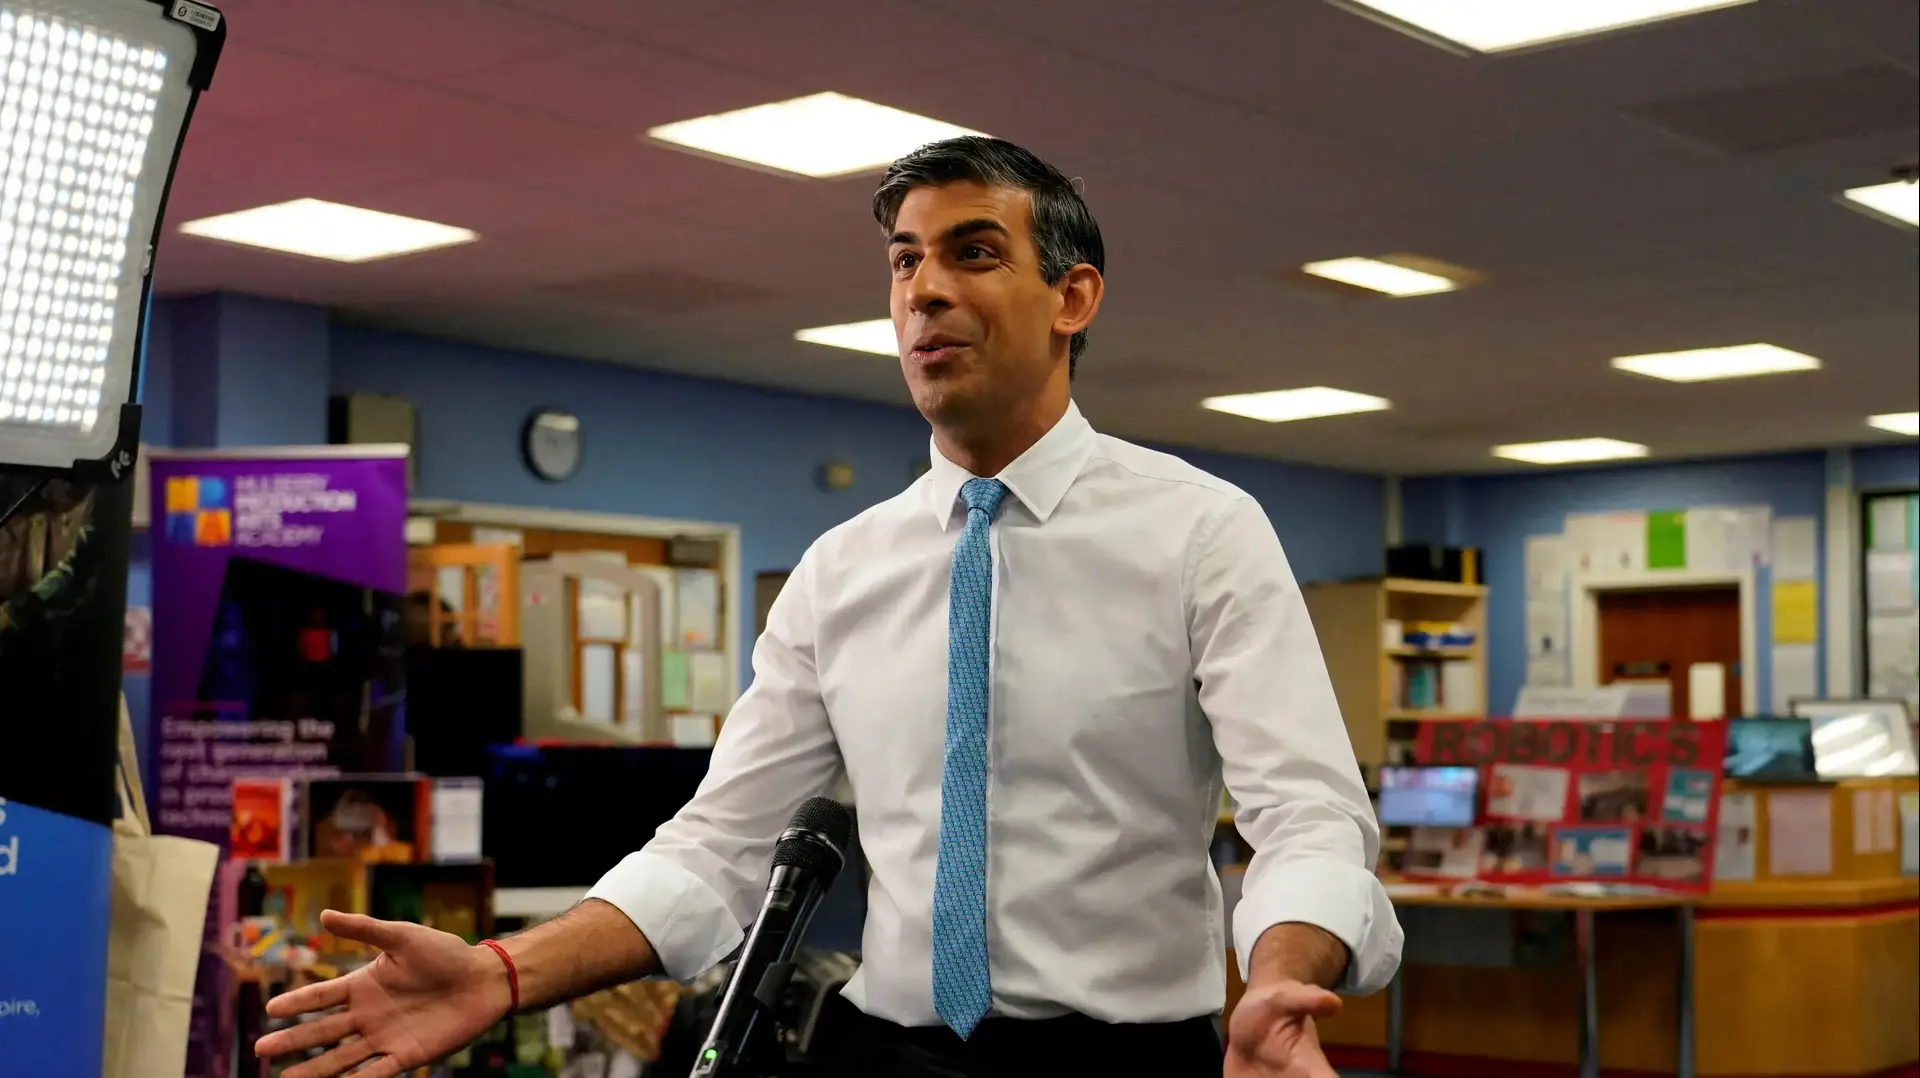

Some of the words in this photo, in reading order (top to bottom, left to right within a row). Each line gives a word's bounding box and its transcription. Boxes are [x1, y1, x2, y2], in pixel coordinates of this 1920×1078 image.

[235, 490, 357, 513] PRODUCTION
[236, 512, 283, 529] ARTS
[236, 527, 324, 547] ACADEMY
[161, 718, 295, 743] Empowering
[298, 718, 335, 739] the
[162, 742, 206, 761] next
[212, 740, 328, 765] generation
[1430, 721, 1700, 766] ROBOTICS
[161, 762, 184, 783] of
